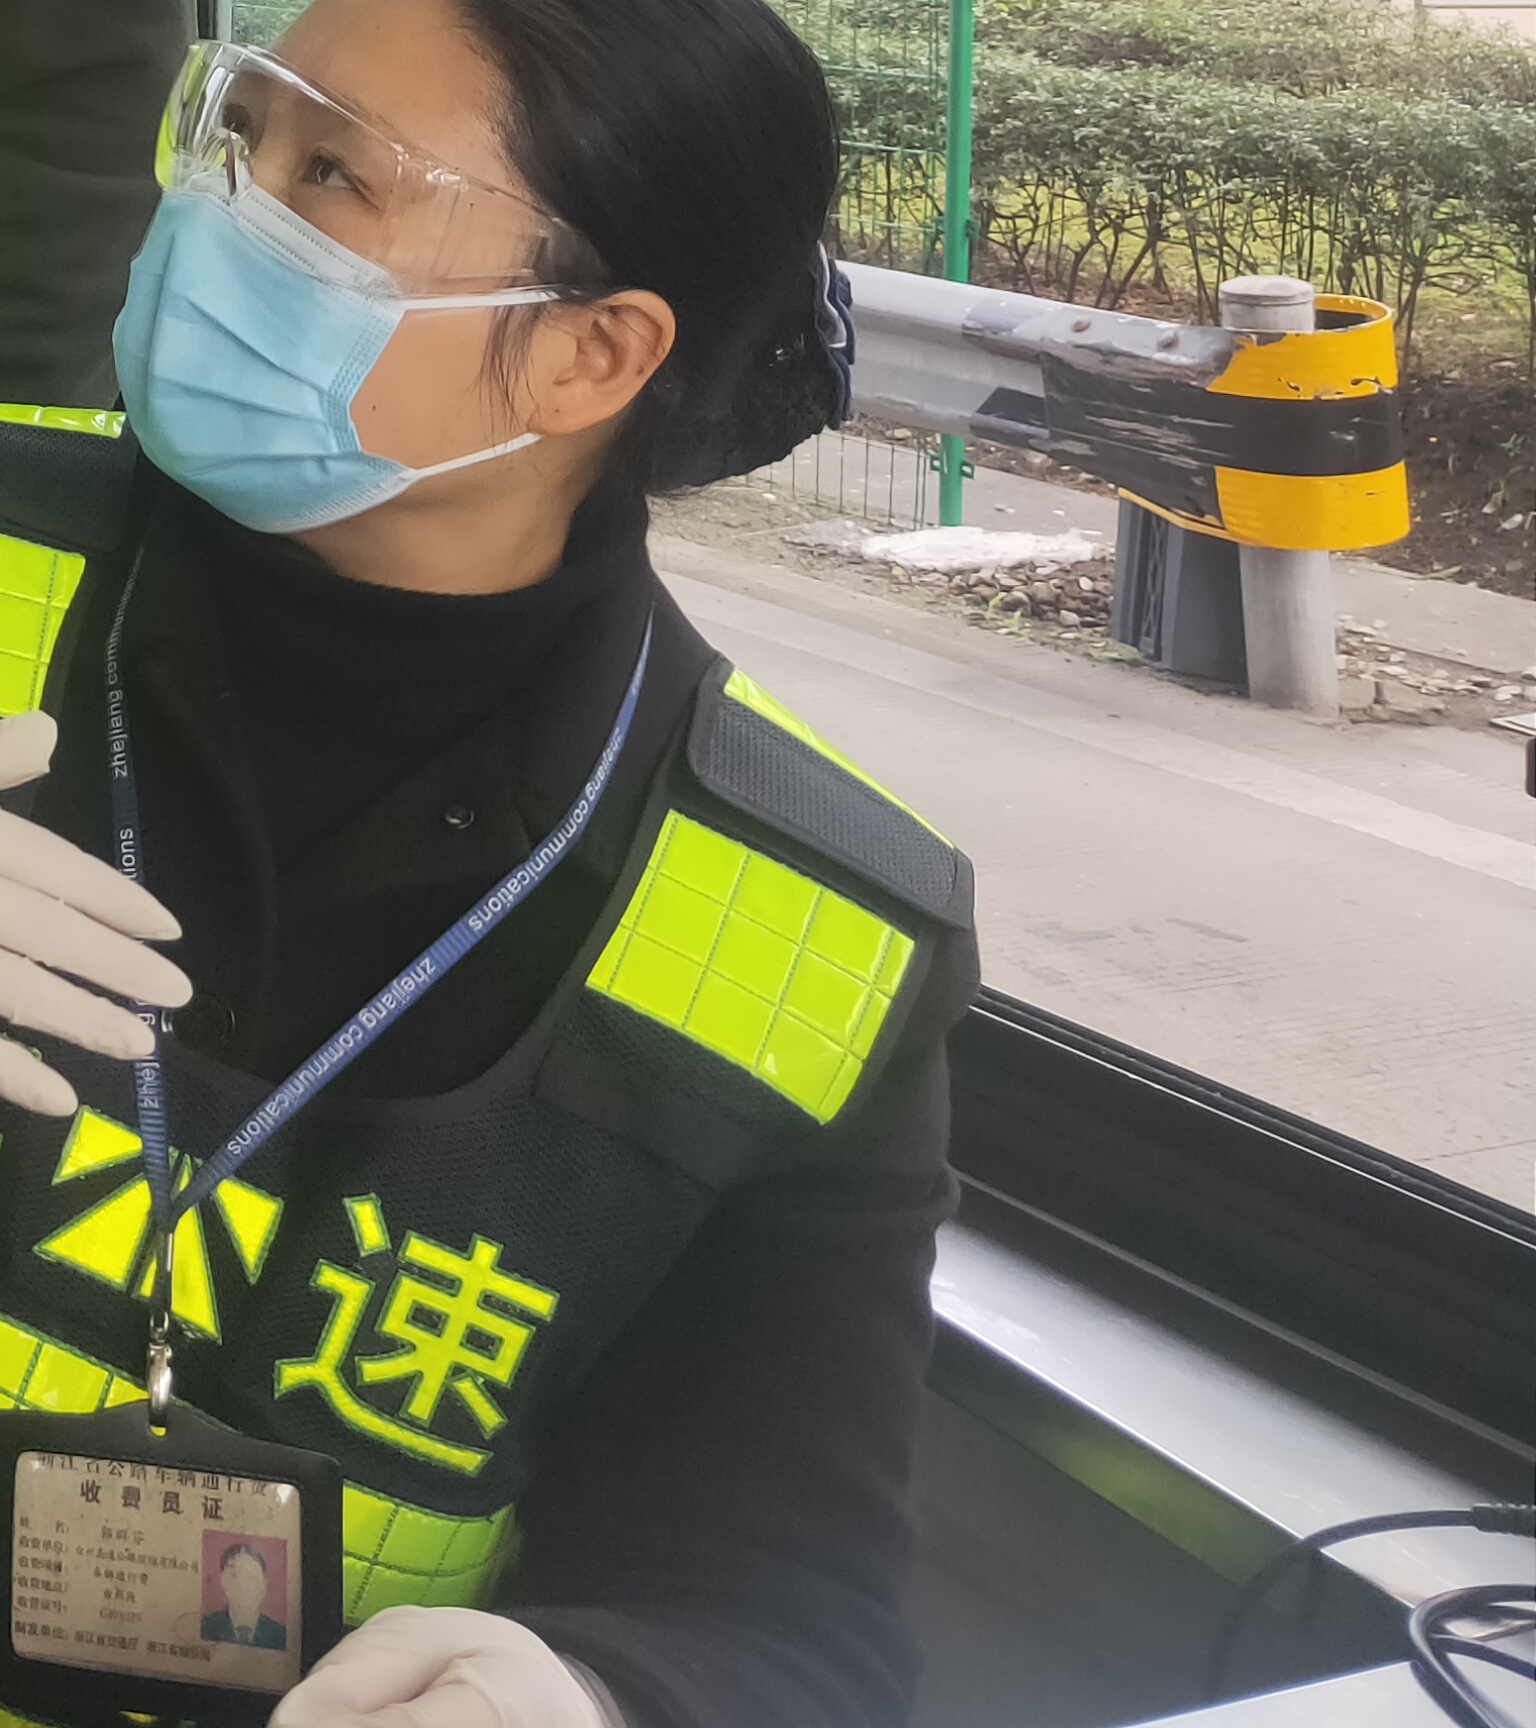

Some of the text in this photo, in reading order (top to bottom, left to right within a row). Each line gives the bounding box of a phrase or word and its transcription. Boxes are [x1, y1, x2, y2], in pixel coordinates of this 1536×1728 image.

[110, 685, 129, 778] zhejiang
[467, 798, 592, 932] communications
[227, 958, 436, 1156] zhejiang communications
[273, 1192, 559, 1475] 速
[79, 1478, 225, 1521] 收费员证
